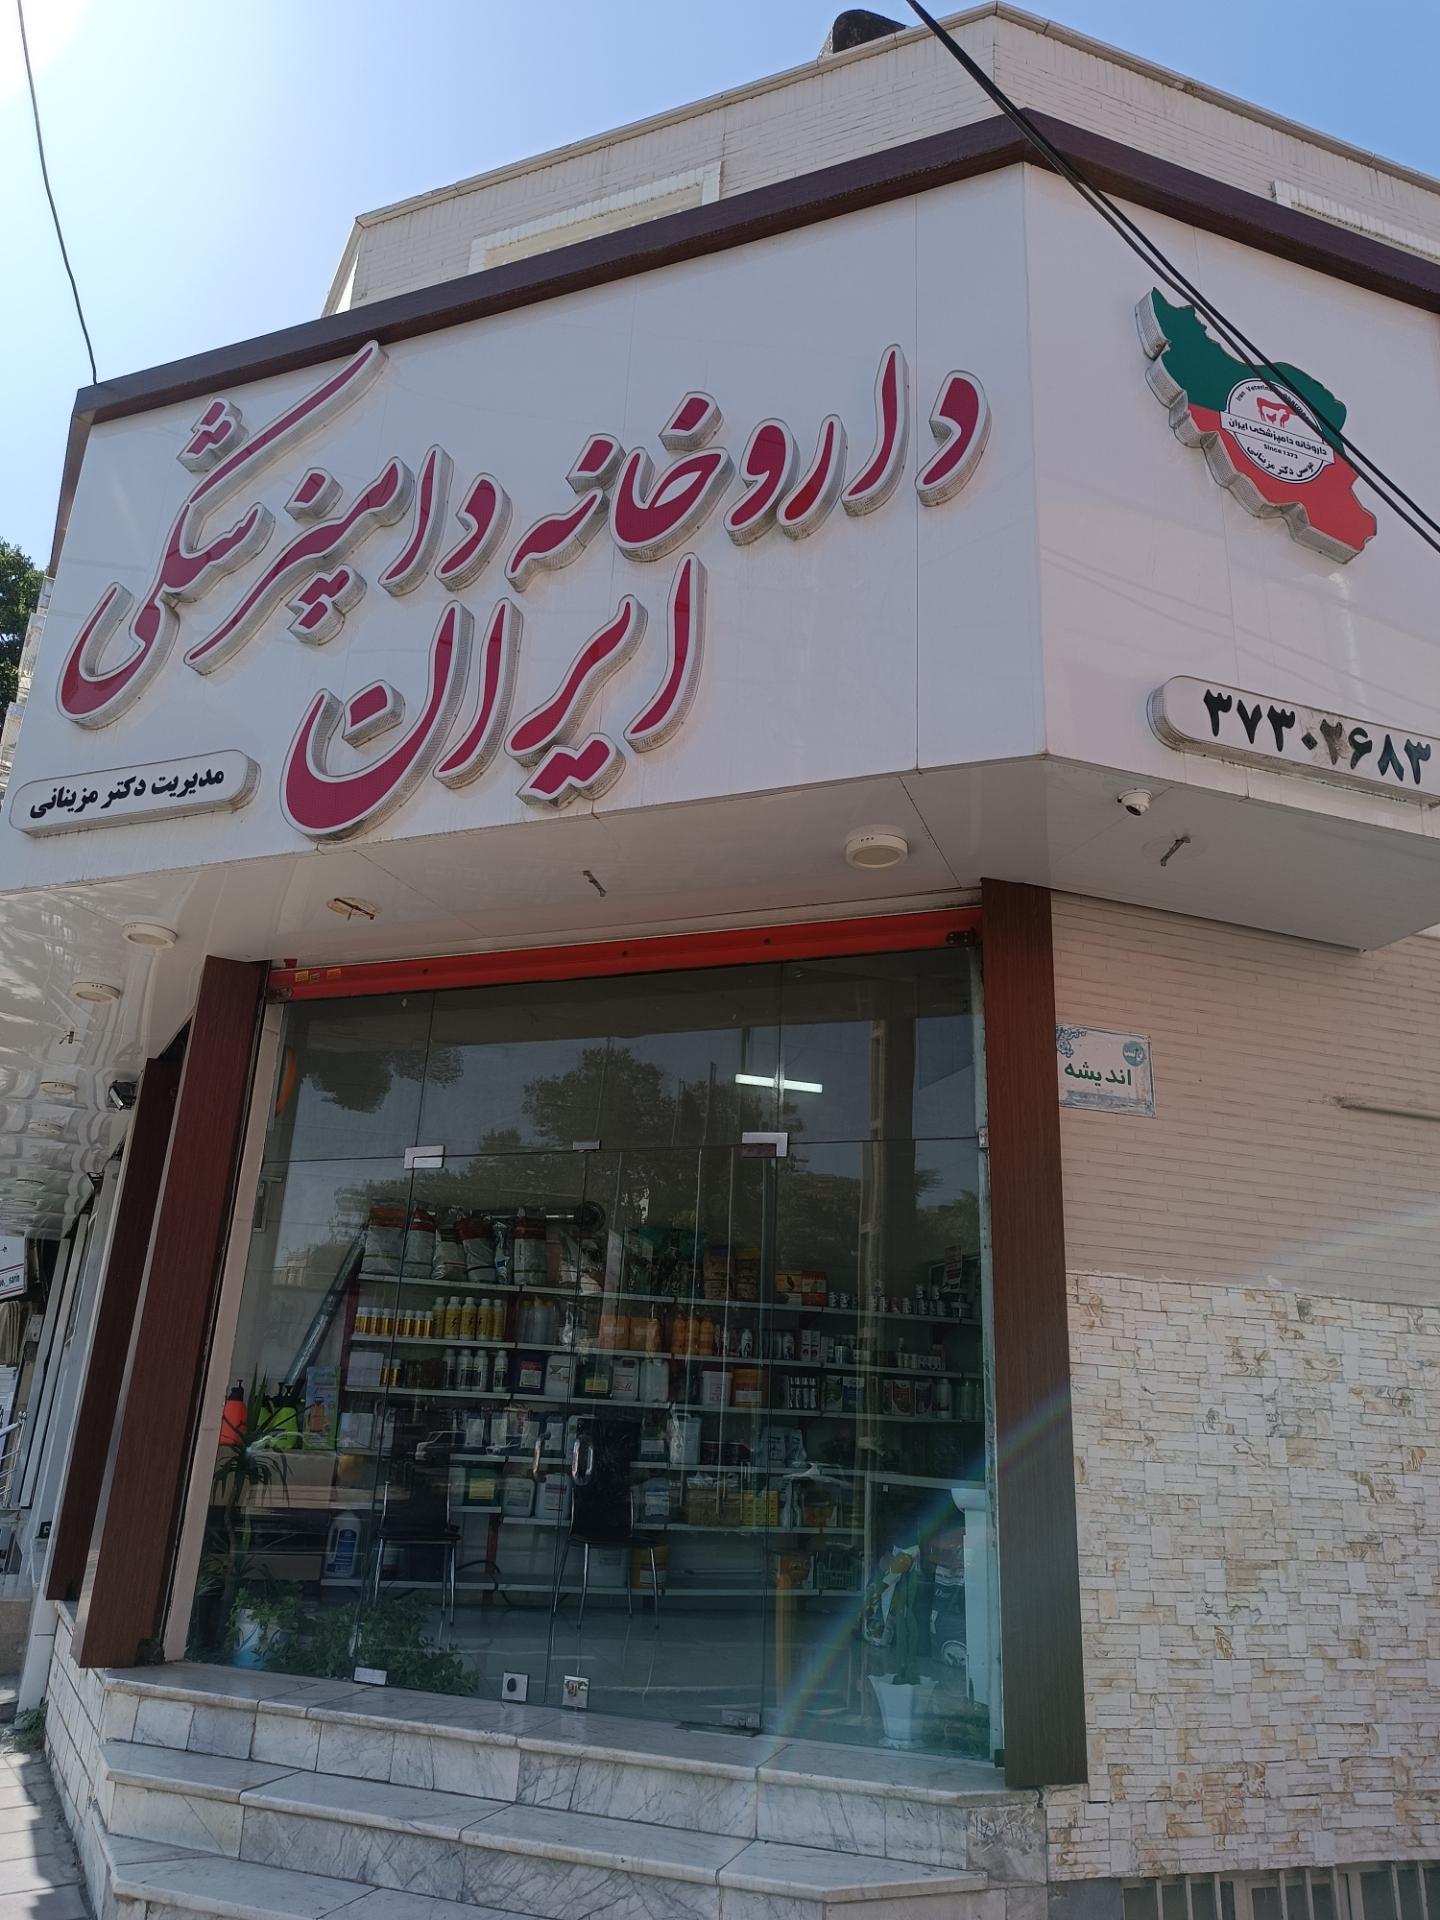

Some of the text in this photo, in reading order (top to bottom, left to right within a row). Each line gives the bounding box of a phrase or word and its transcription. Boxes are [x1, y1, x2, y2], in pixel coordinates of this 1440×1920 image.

[57, 340, 991, 730] داروخانه دامپزشکی
[281, 552, 708, 844] ایران
[29, 768, 224, 819] مدیریت دکتر مزینانی
[1064, 1060, 1132, 1086] اندیشه
